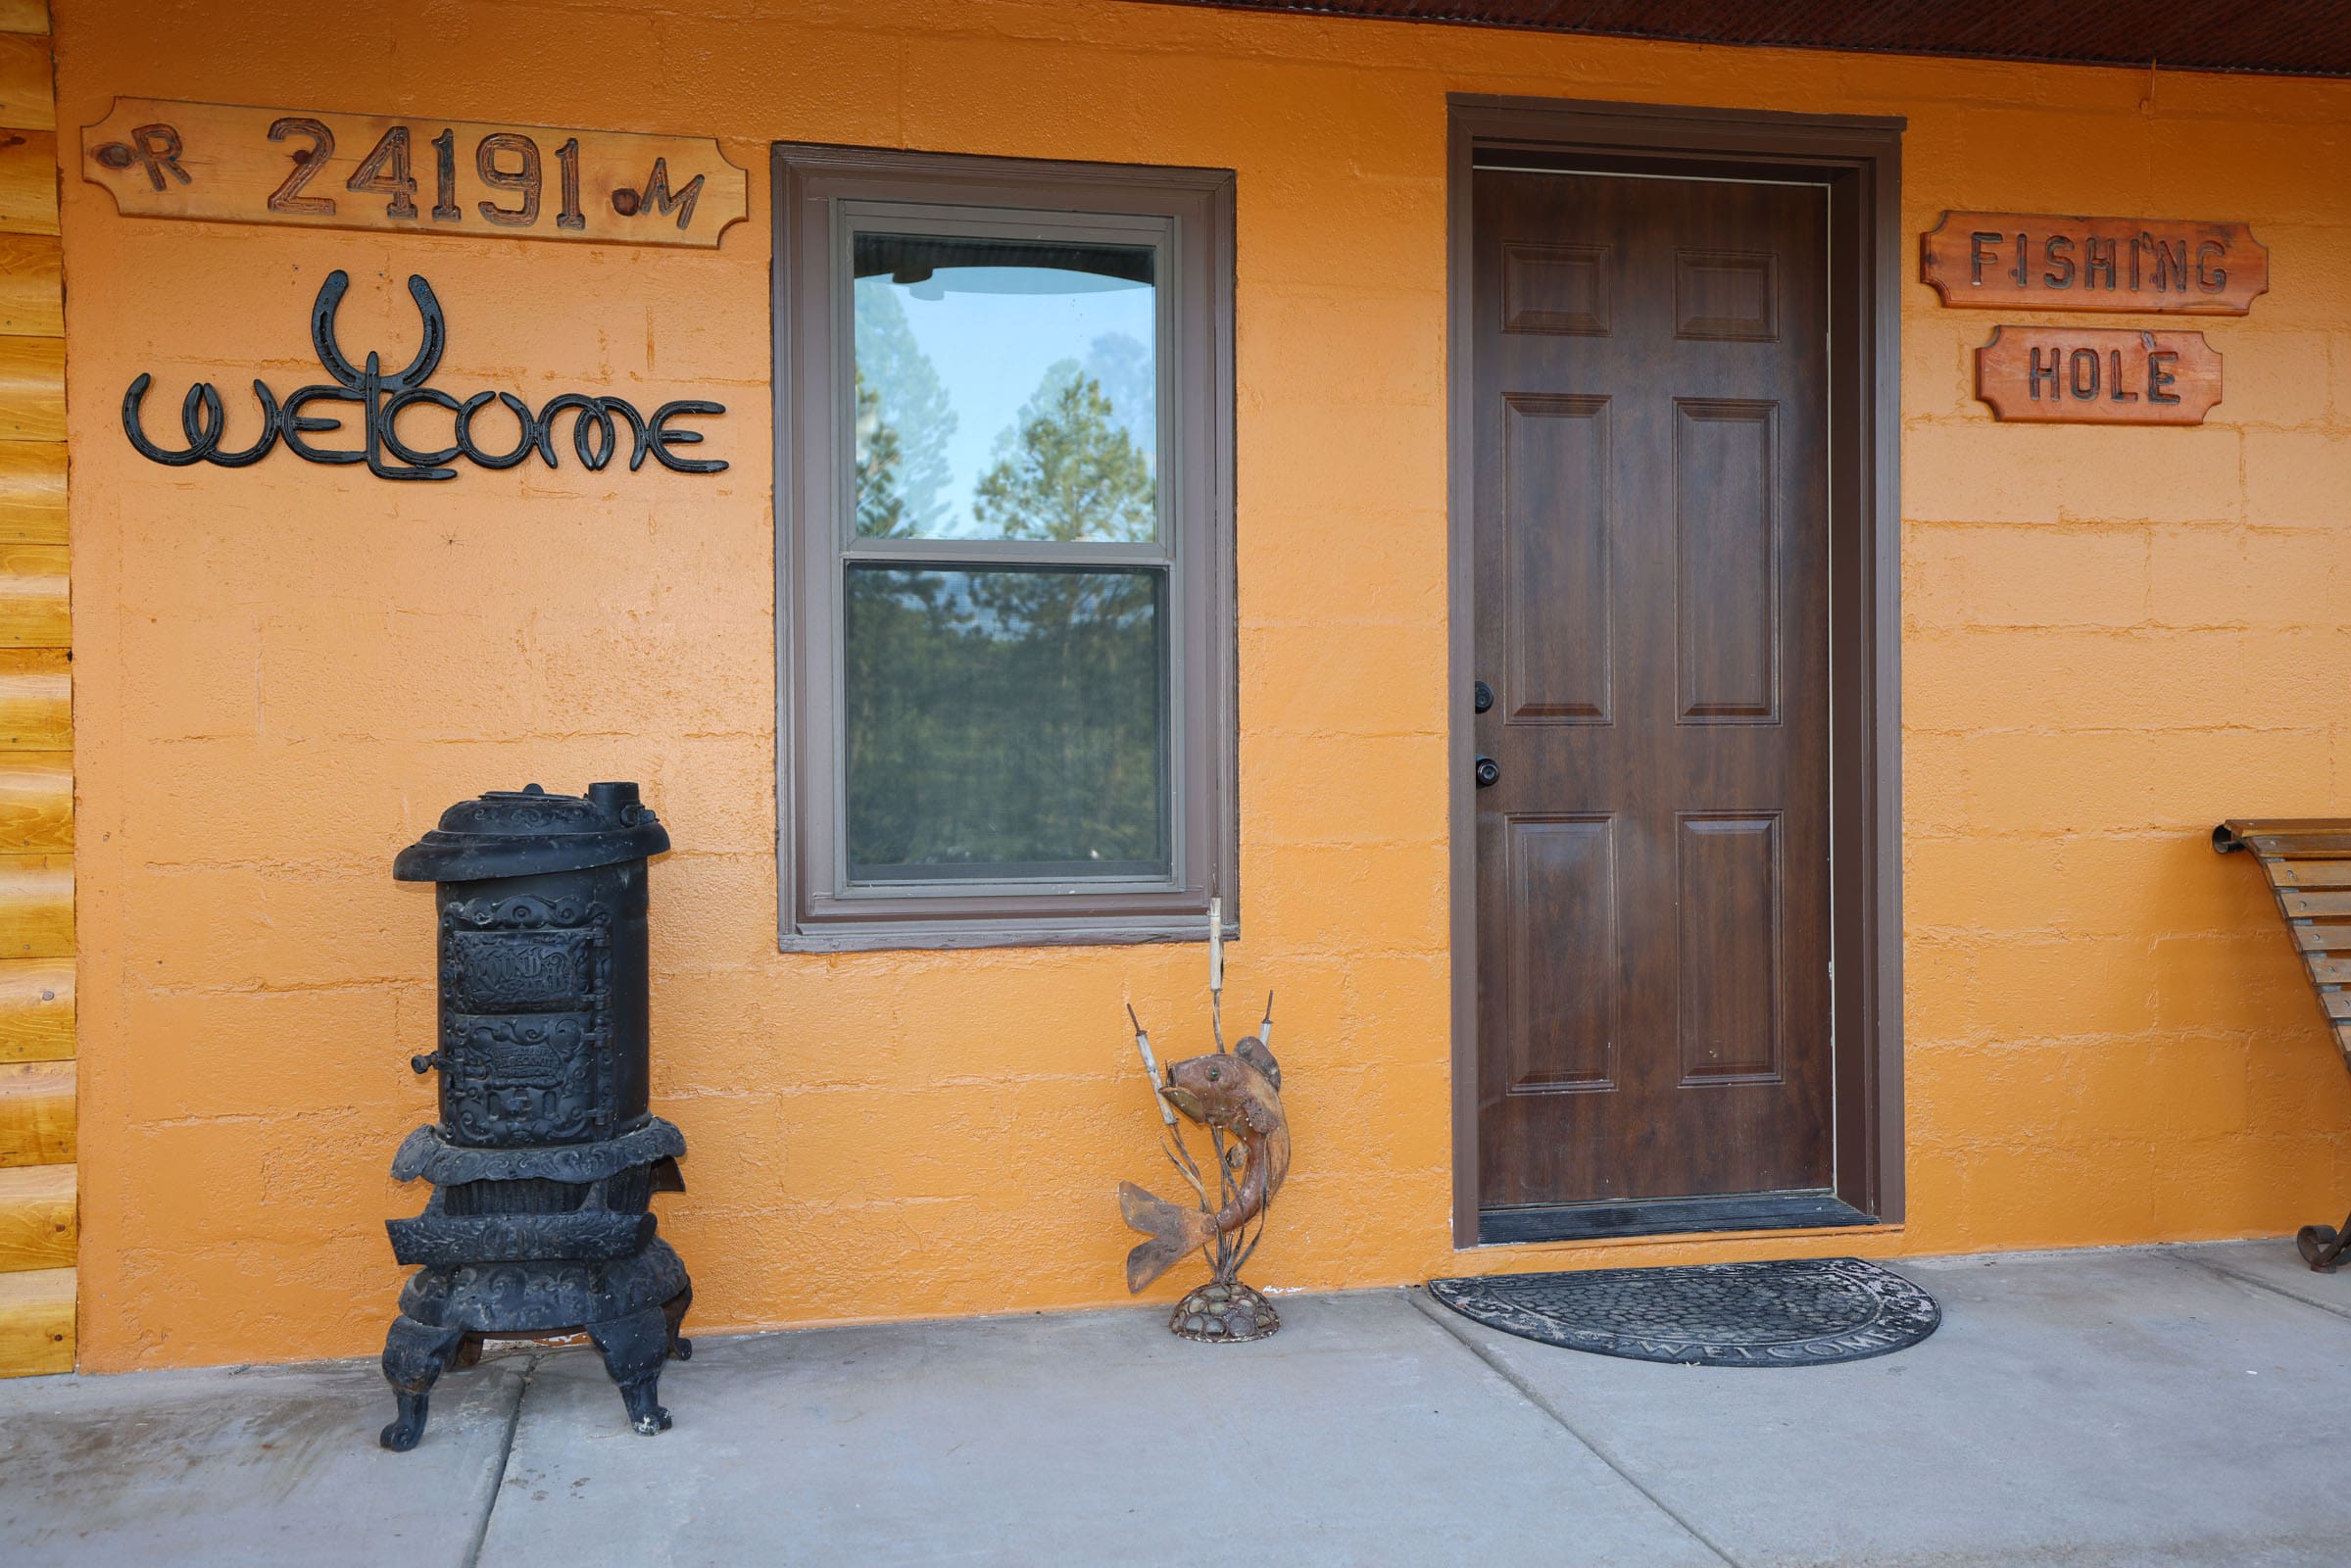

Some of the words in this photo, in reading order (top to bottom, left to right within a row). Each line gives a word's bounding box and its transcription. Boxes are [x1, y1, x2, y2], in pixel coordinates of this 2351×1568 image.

[131, 123, 192, 191] R
[267, 117, 586, 229] 24191
[641, 157, 705, 229] M
[1971, 231, 2228, 293] FISHING
[2030, 347, 2181, 405] HOLE
[1636, 1327, 1900, 1359] WELCOME
